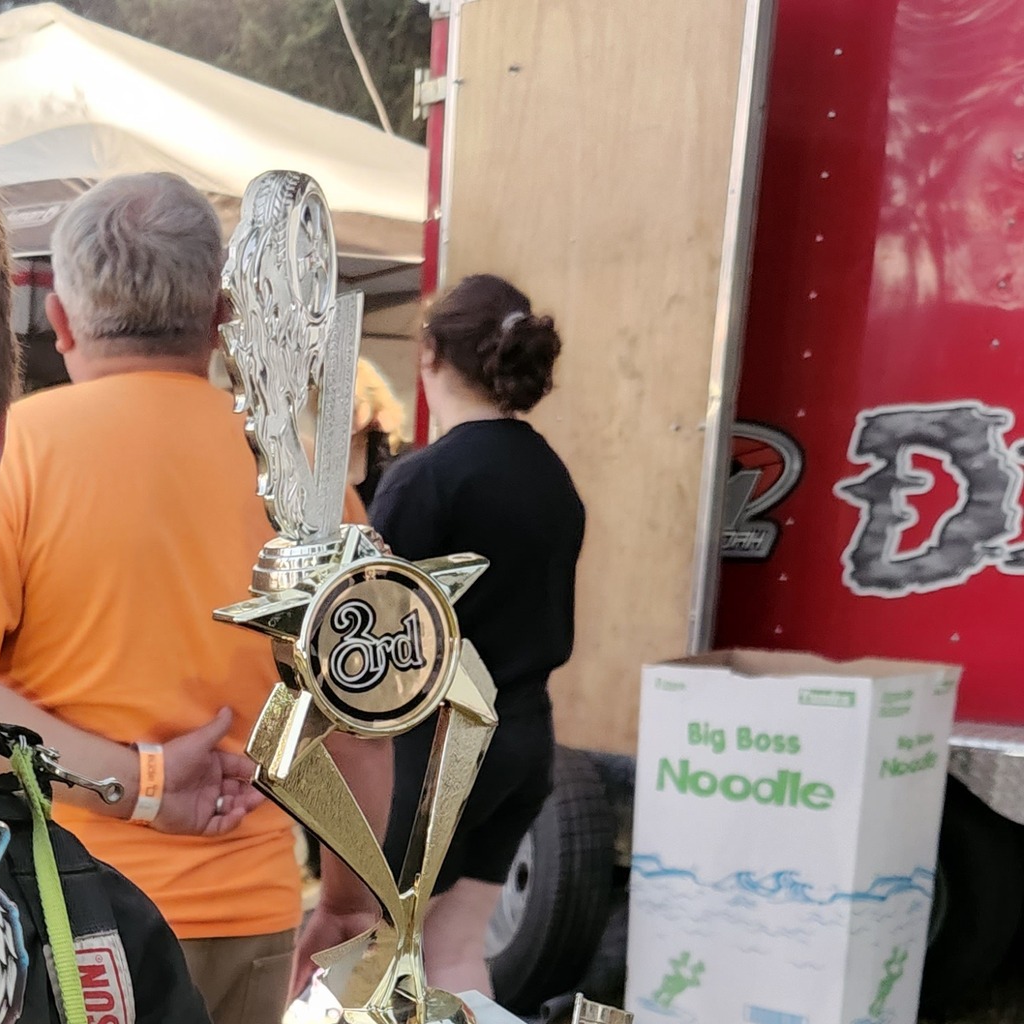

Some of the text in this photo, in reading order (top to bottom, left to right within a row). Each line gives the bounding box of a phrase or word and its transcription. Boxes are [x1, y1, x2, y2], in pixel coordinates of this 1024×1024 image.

[329, 598, 427, 692] 3rd
[687, 721, 801, 755] Big Boss
[655, 758, 835, 811] Noodle
